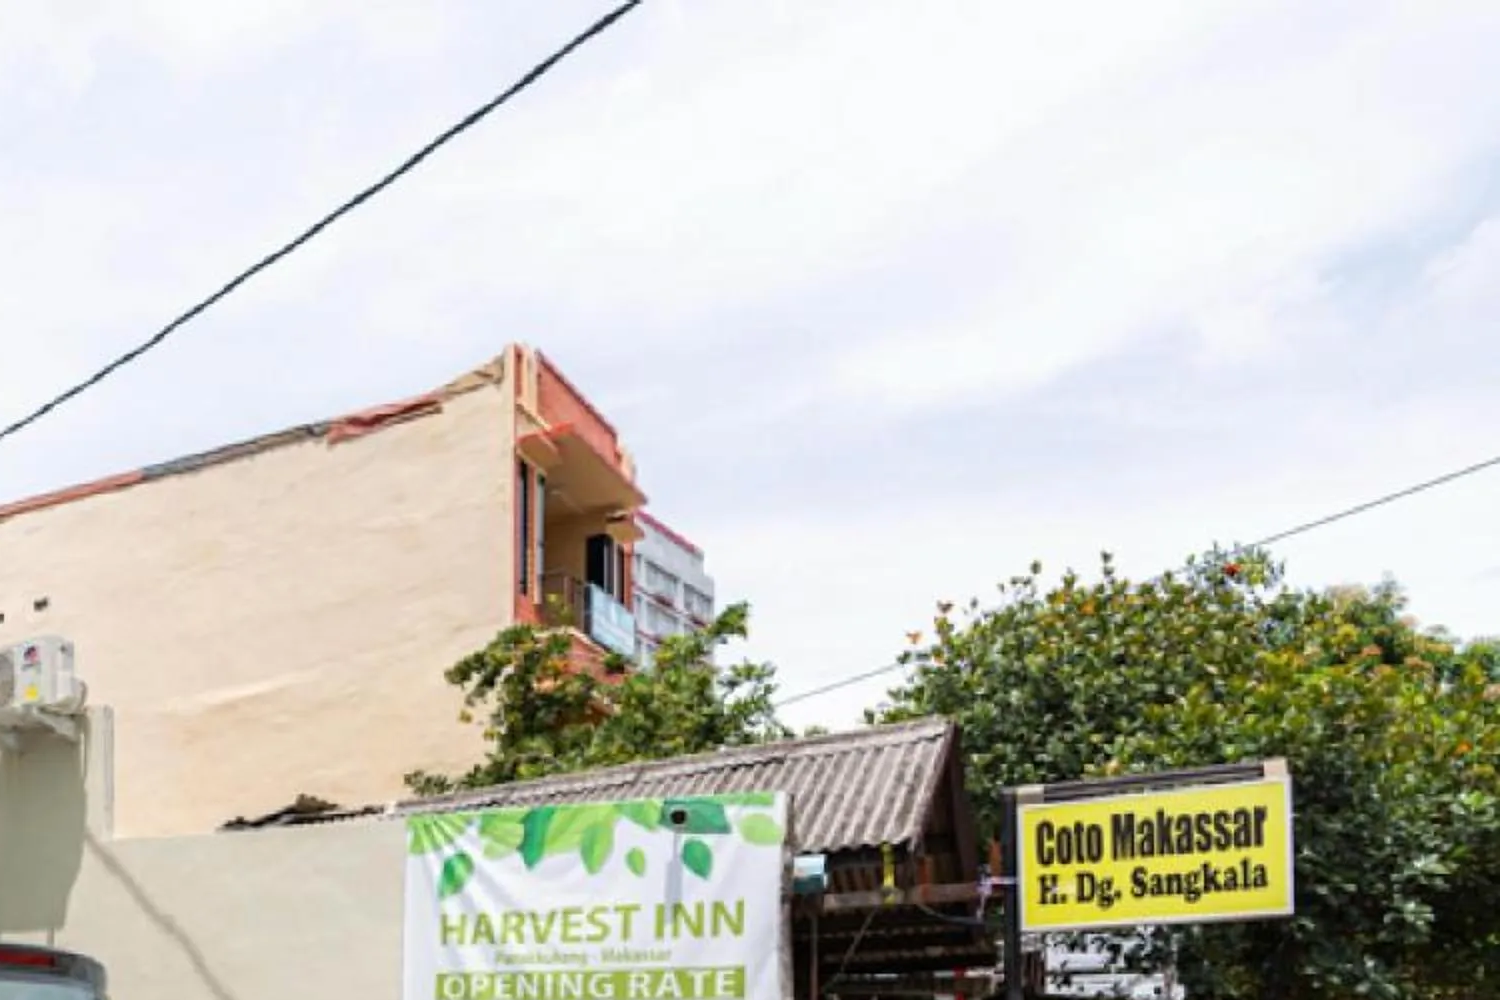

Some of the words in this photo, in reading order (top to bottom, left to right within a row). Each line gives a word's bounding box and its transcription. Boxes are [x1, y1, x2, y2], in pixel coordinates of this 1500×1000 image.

[1035, 820, 1104, 865] Coto
[1110, 805, 1268, 861] Makassar
[1037, 873, 1068, 905] H.
[1076, 872, 1121, 909] Dg.
[1131, 856, 1268, 902] Sangkala
[439, 903, 641, 945] HARVEST
[654, 898, 746, 941] INN
[443, 974, 615, 1000] OPENING
[628, 969, 736, 999] RATE
